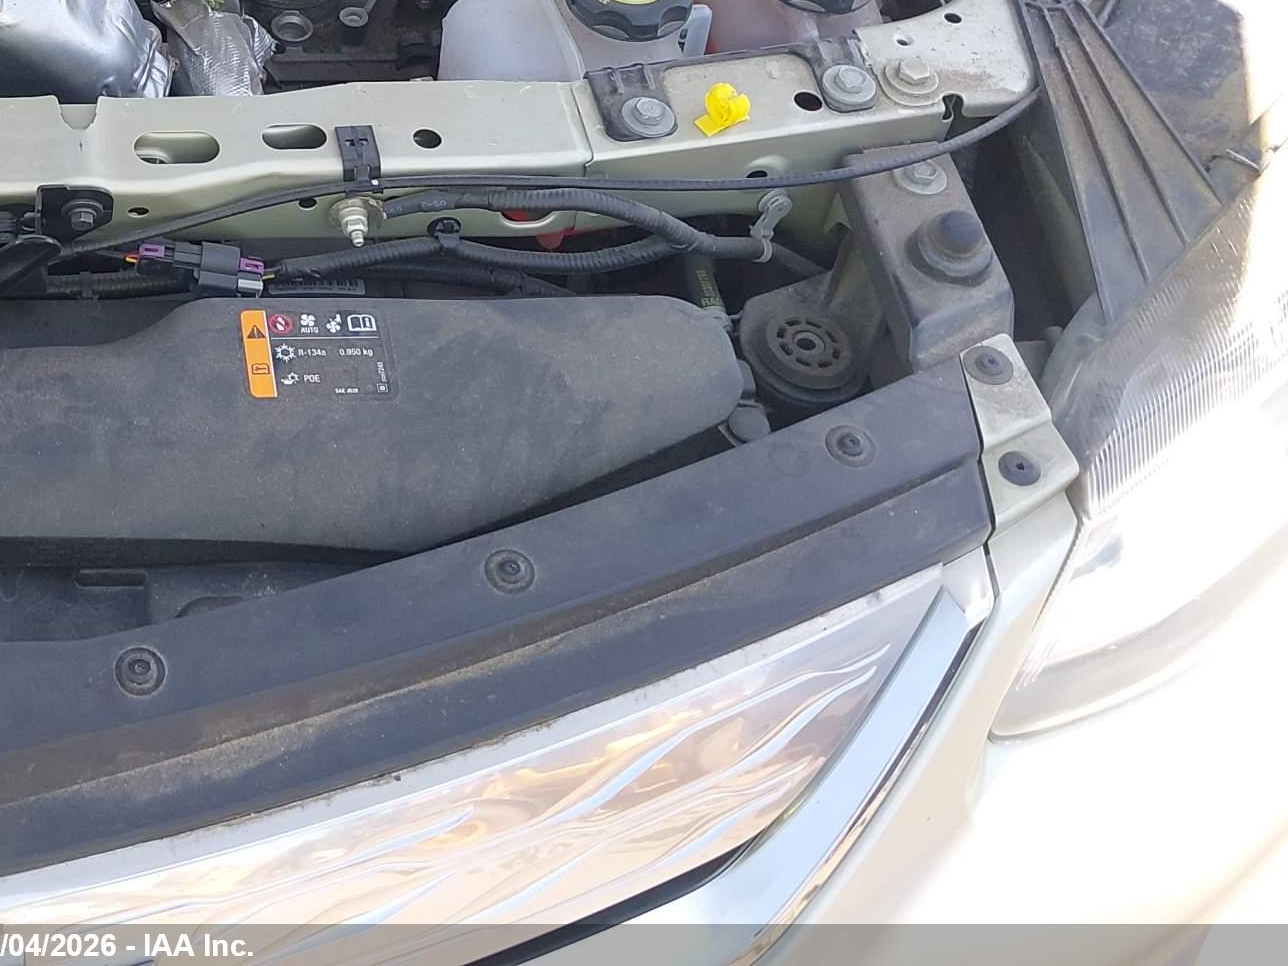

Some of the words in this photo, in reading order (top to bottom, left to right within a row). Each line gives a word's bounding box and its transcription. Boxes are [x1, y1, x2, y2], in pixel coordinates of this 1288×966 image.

[297, 348, 327, 357] R-134a
[362, 347, 374, 357] kg
[303, 374, 321, 383] POE
